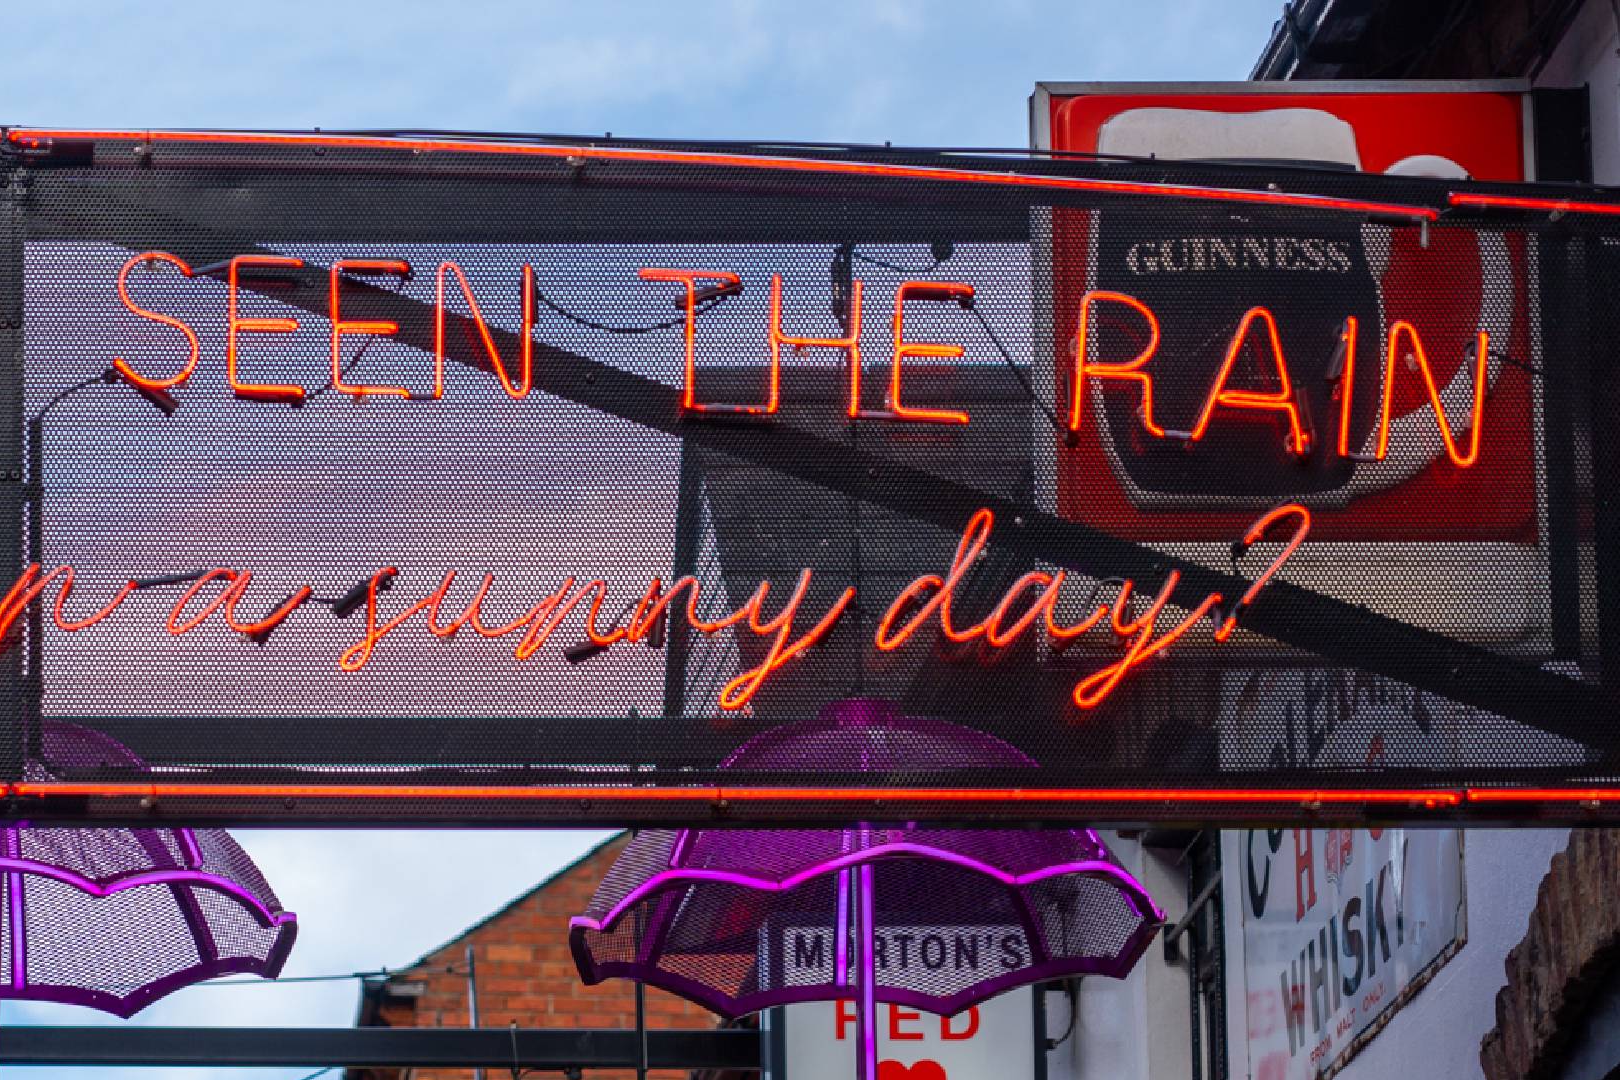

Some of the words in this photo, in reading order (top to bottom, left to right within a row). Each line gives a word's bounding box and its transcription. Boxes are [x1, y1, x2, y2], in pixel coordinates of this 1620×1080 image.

[1126, 237, 1353, 275] GUINNESS
[112, 250, 533, 400] SEEN
[636, 265, 976, 424] THE
[1070, 290, 1489, 467] RAIN
[164, 566, 312, 635] a
[340, 565, 857, 712] sunny
[1280, 836, 1410, 1058] WHISKY
